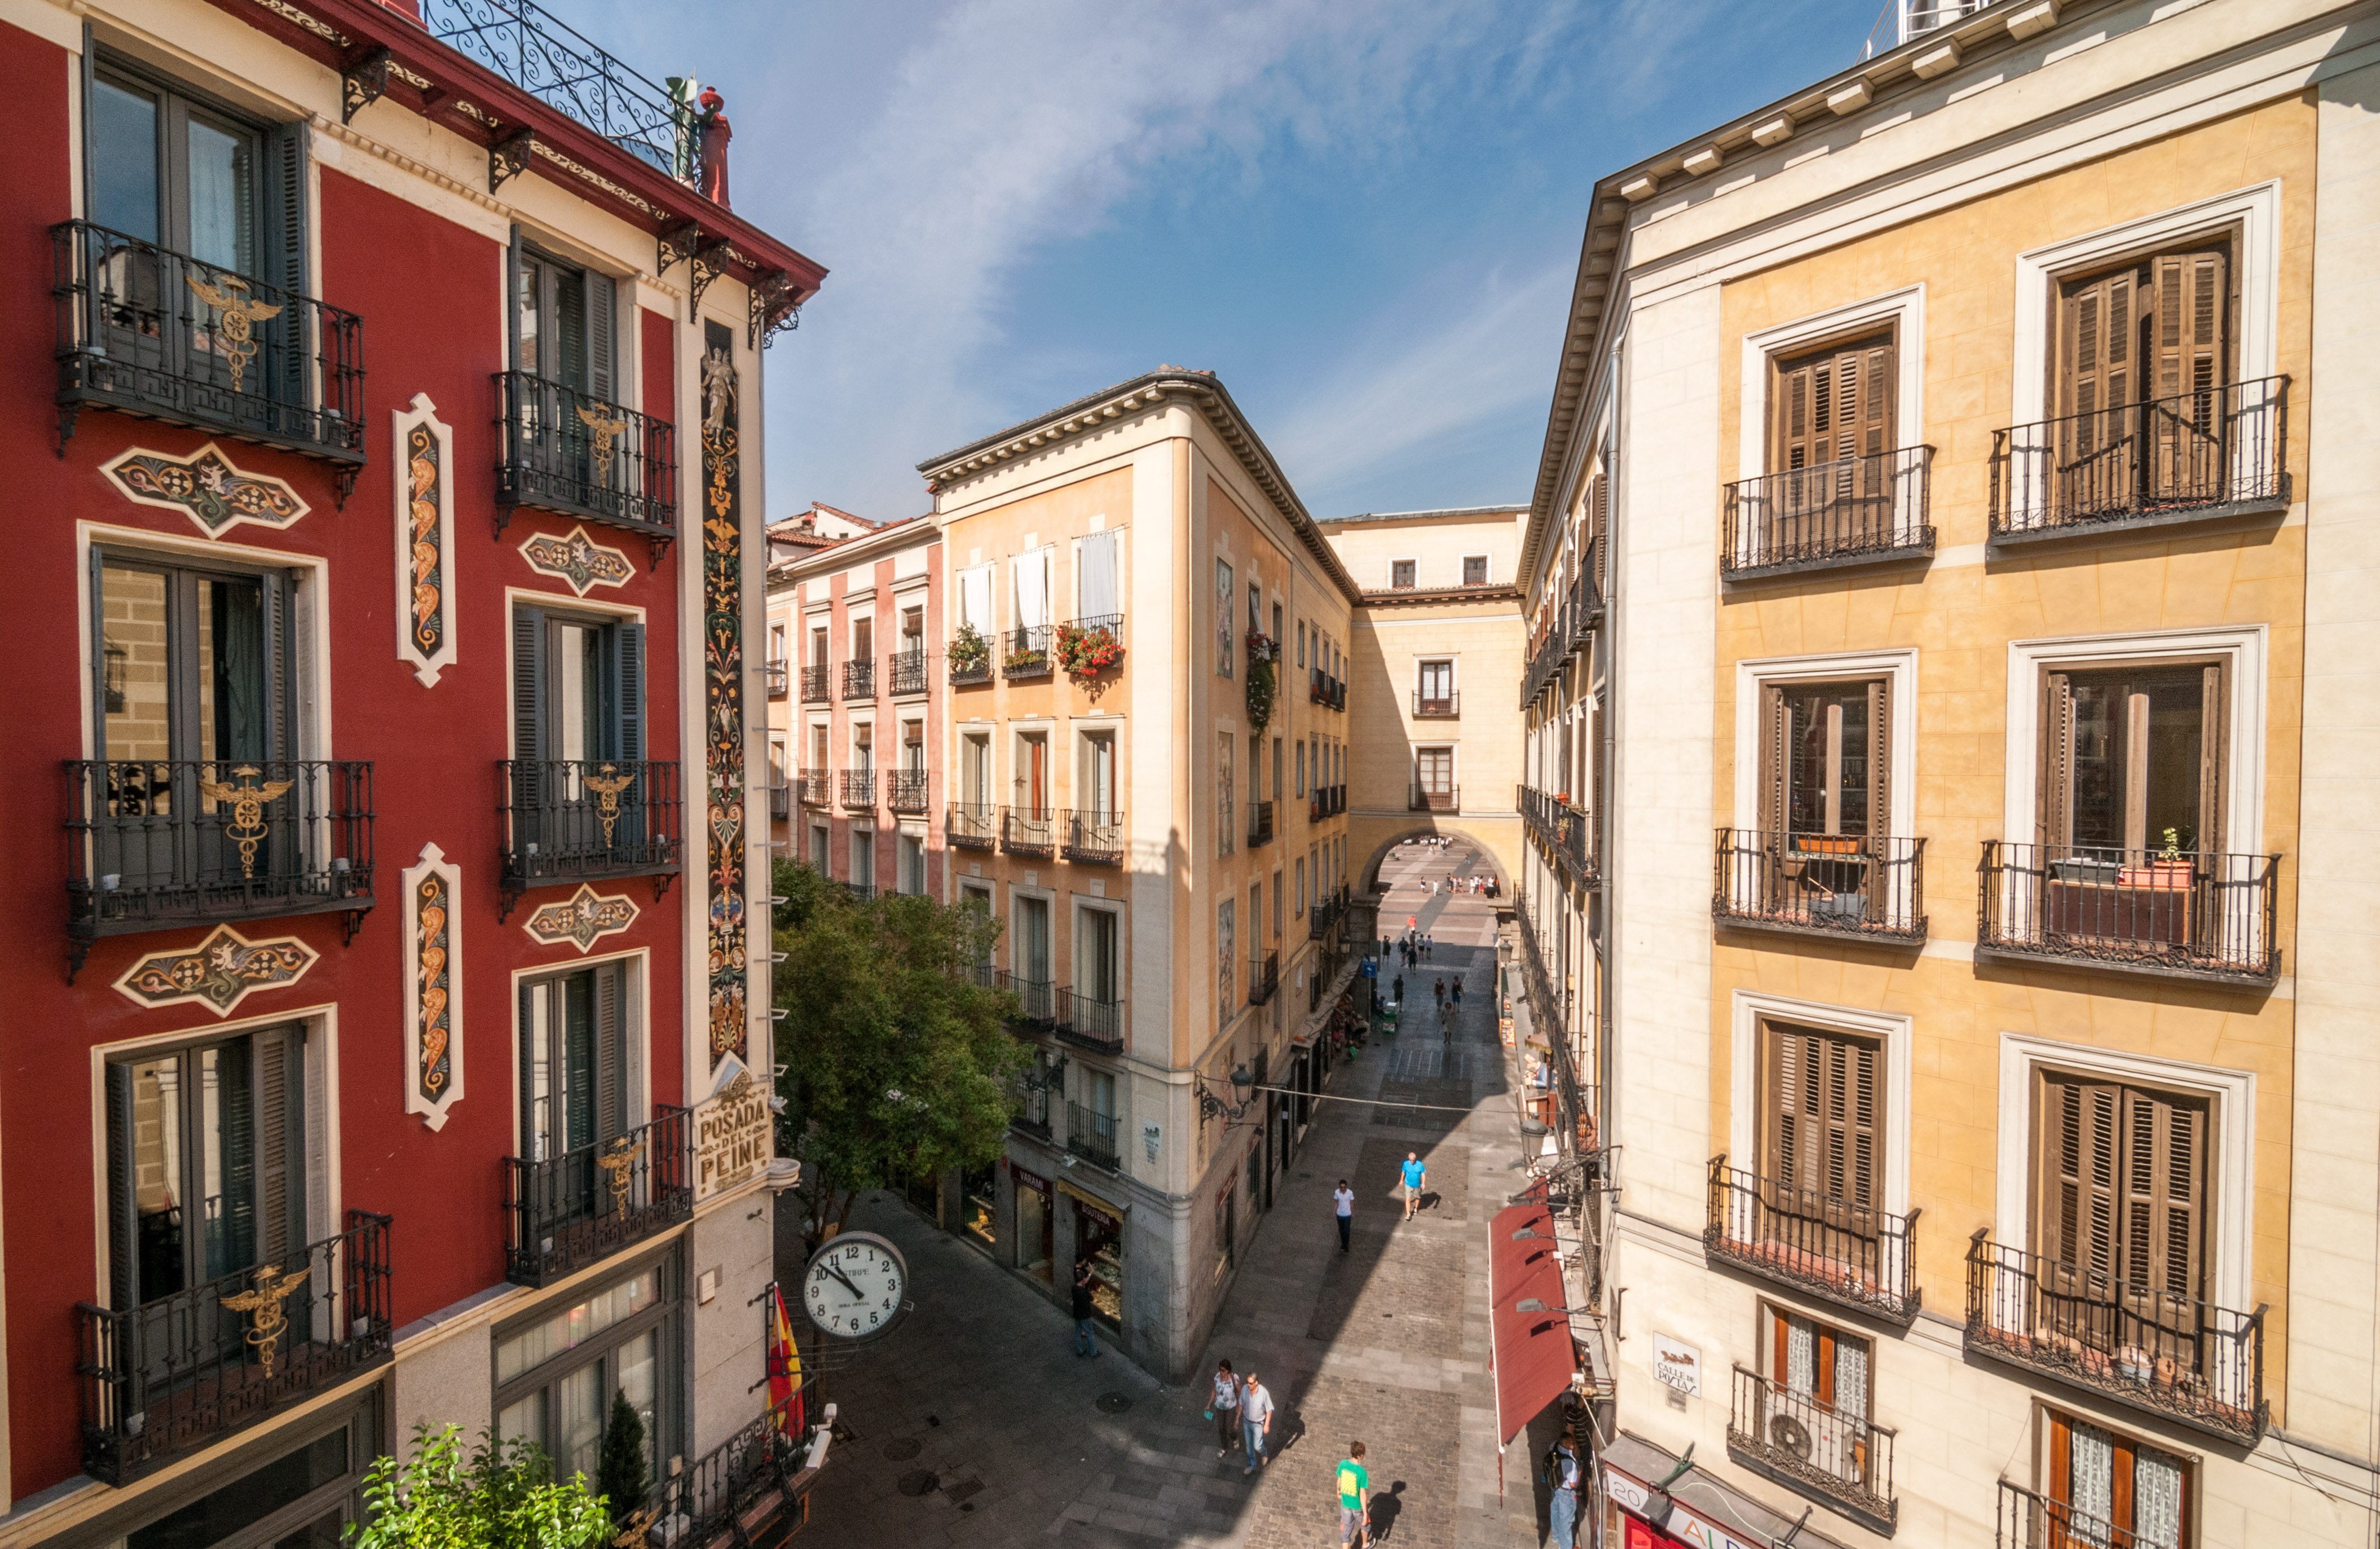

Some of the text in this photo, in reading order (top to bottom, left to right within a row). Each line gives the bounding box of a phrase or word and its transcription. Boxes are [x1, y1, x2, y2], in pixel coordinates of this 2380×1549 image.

[701, 1100, 764, 1144] POSADA
[722, 1132, 744, 1148] DEL
[701, 1133, 765, 1184] PEINE
[1020, 1170, 1043, 1190] VARAMI
[845, 1247, 859, 1259] 12
[869, 1249, 874, 1261] 1
[830, 1254, 840, 1266] 11
[882, 1261, 890, 1273] 2
[815, 1269, 828, 1280] 10
[888, 1279, 896, 1291] 3
[811, 1286, 819, 1297] 9
[882, 1298, 891, 1309] 4
[817, 1304, 825, 1317] 8
[832, 1315, 840, 1327] 7
[870, 1312, 878, 1323] 5
[850, 1318, 859, 1330] 6
[1658, 1362, 1695, 1383] CALLE DE
[1659, 1370, 1696, 1393] POSTAS
[1614, 1481, 1639, 1507] 20
